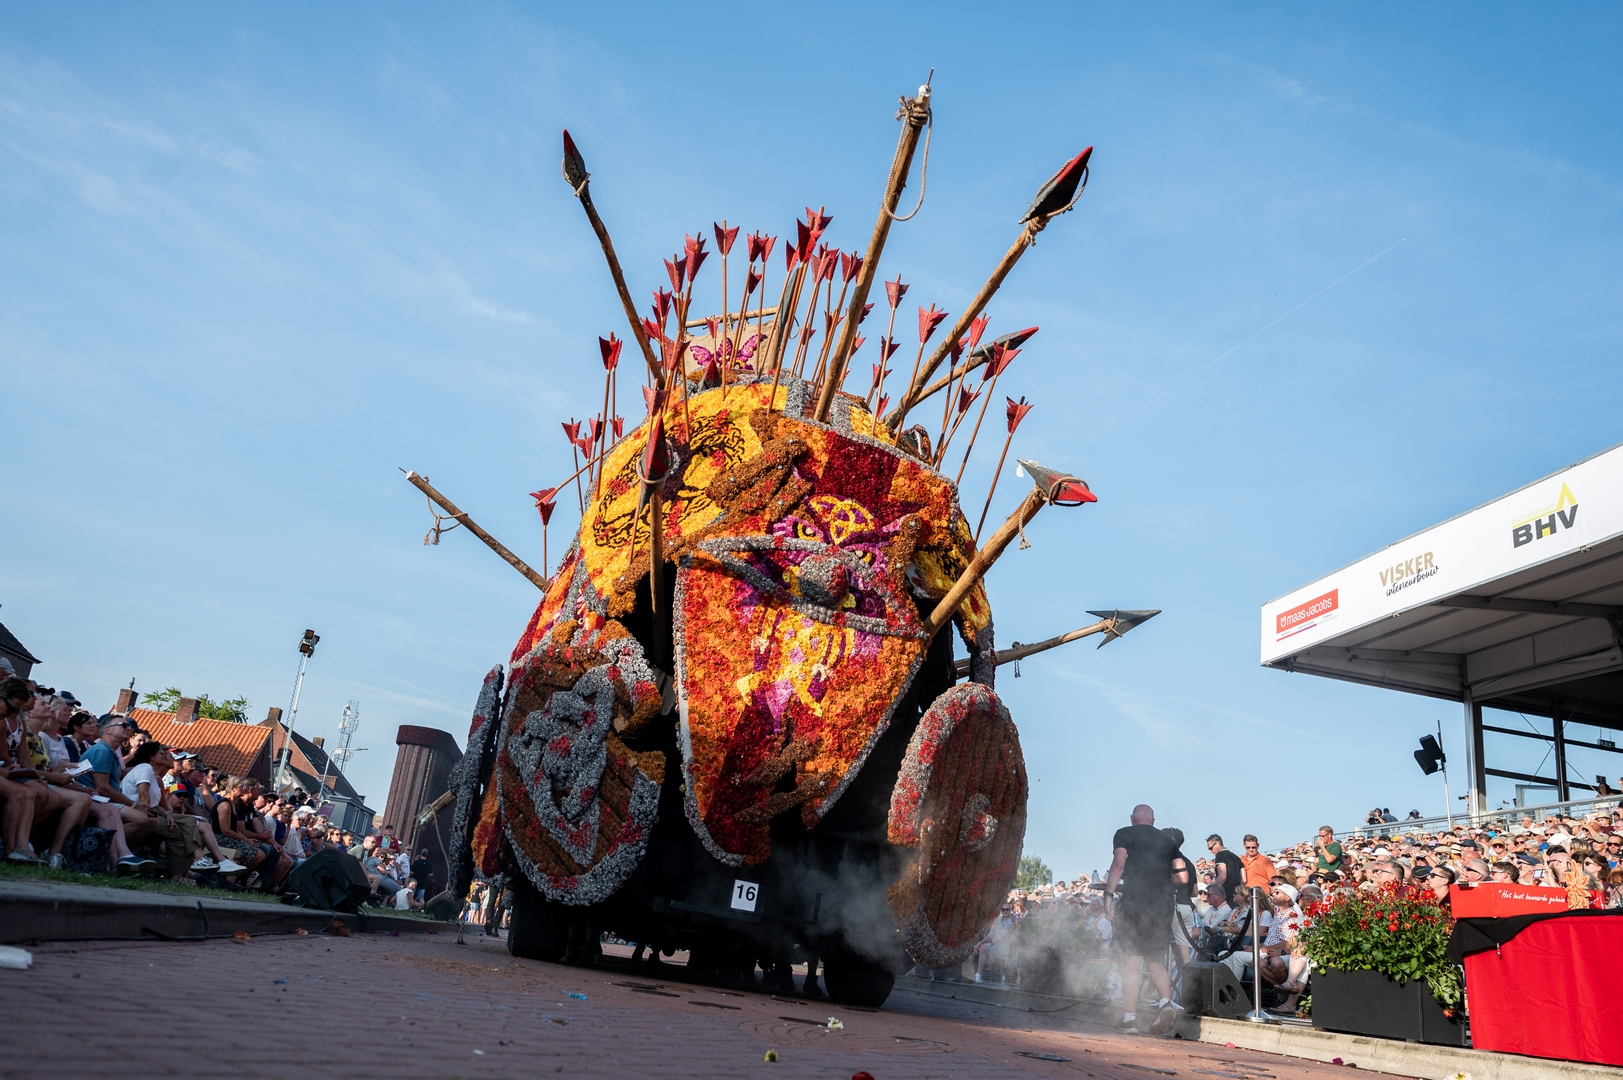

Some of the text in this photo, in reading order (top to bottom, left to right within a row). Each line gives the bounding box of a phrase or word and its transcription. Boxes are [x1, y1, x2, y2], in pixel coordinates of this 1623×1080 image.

[1512, 504, 1579, 548] BHV
[1379, 551, 1434, 587] VISKER
[736, 884, 756, 901] 16
